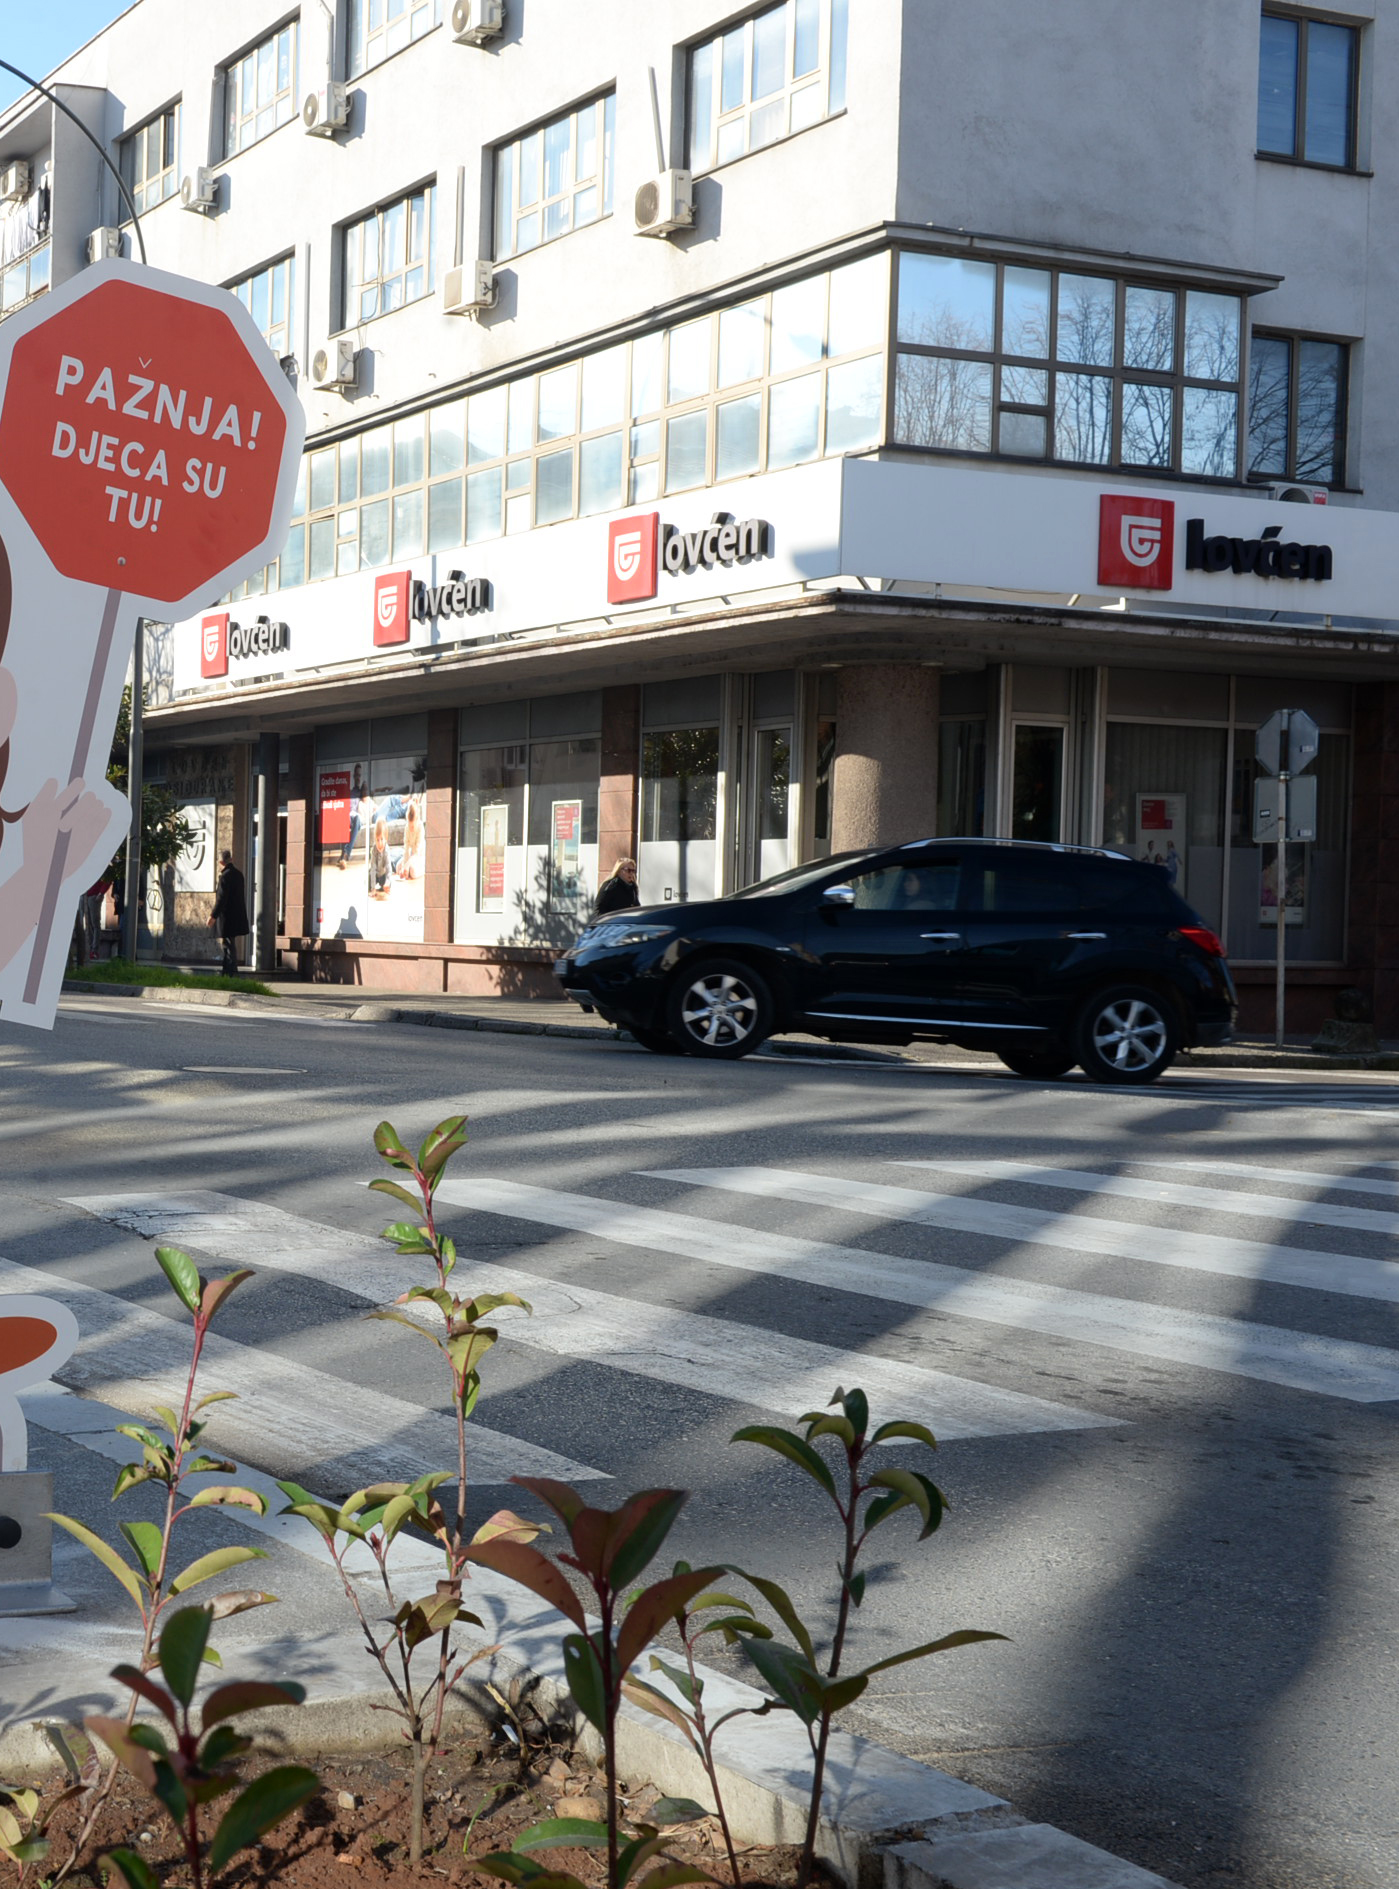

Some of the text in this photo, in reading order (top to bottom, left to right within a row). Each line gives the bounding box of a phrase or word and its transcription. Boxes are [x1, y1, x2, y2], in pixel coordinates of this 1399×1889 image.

[55, 354, 262, 451] PAŽNJA!
[51, 421, 227, 499] DJECA SU
[104, 485, 163, 533] TU!
